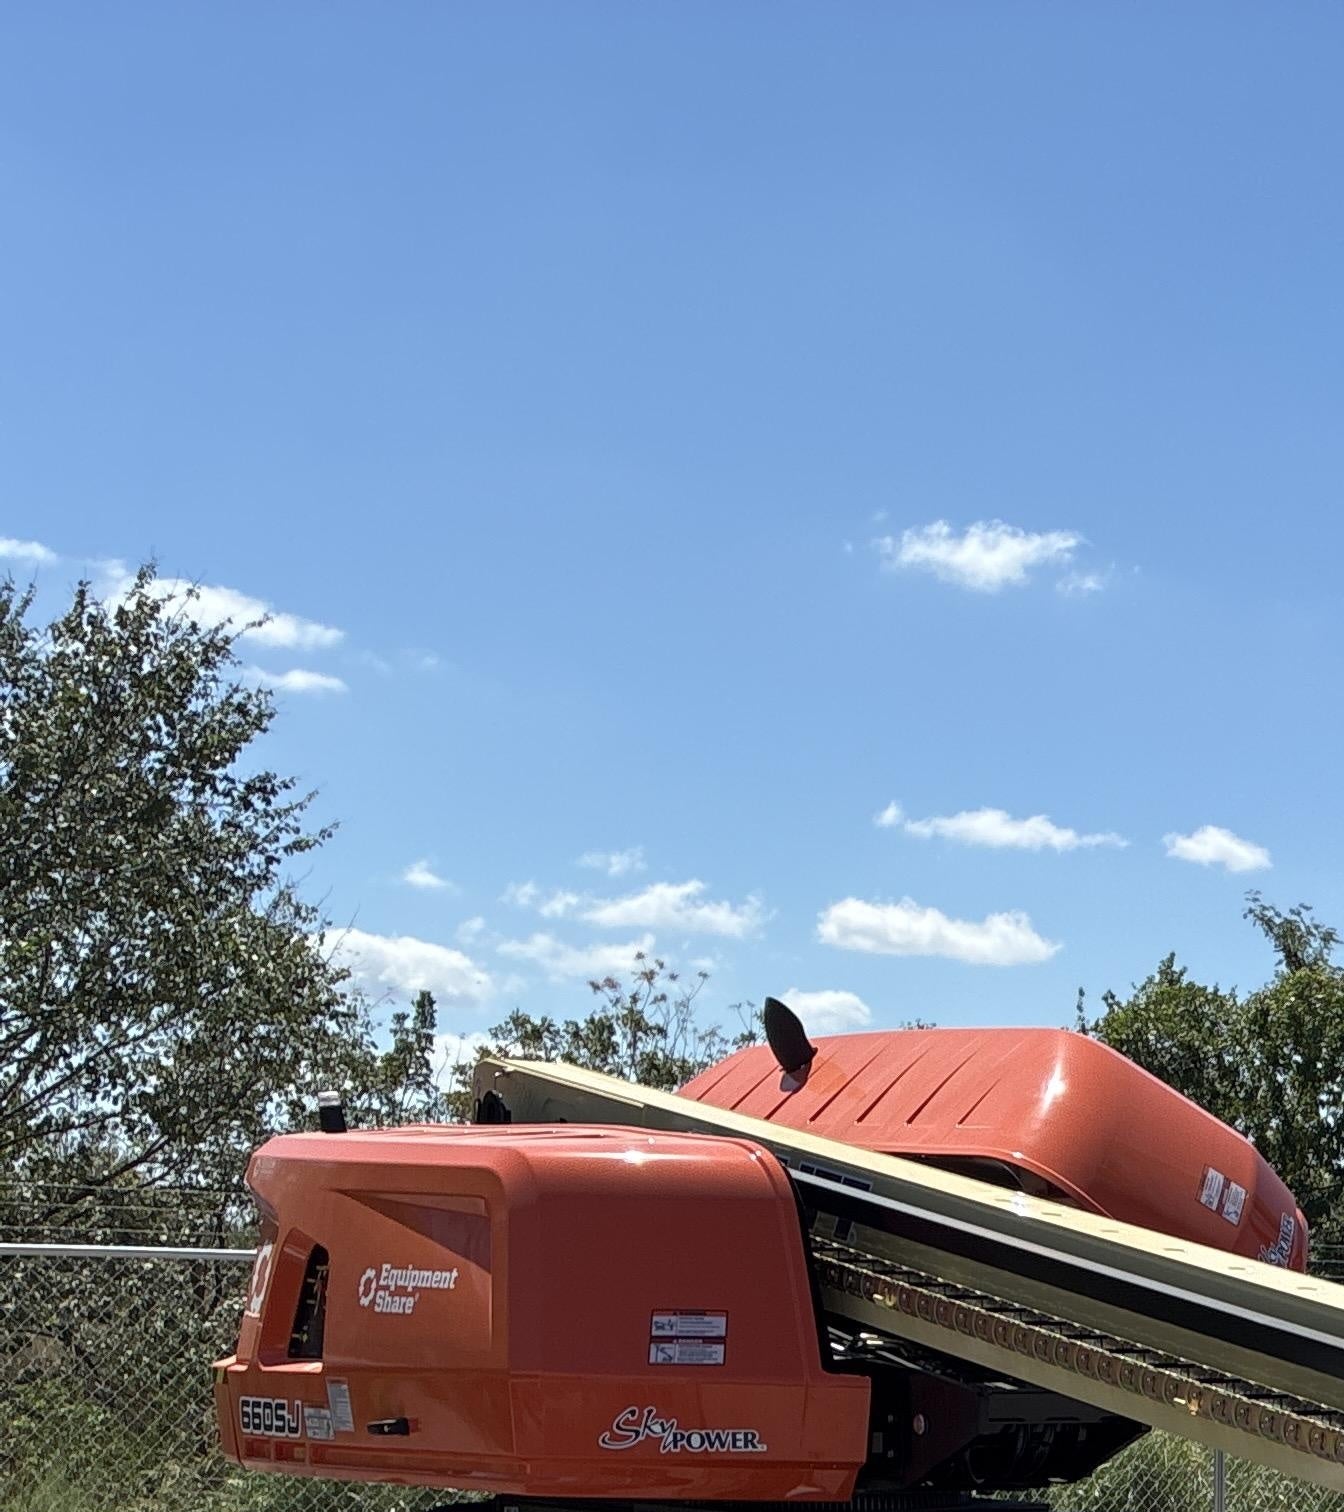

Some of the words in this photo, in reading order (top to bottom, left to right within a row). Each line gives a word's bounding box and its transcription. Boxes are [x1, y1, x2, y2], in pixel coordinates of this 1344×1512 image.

[379, 1263, 459, 1292] Equipment
[374, 1290, 415, 1315] Share
[240, 1396, 302, 1438] 660SJ
